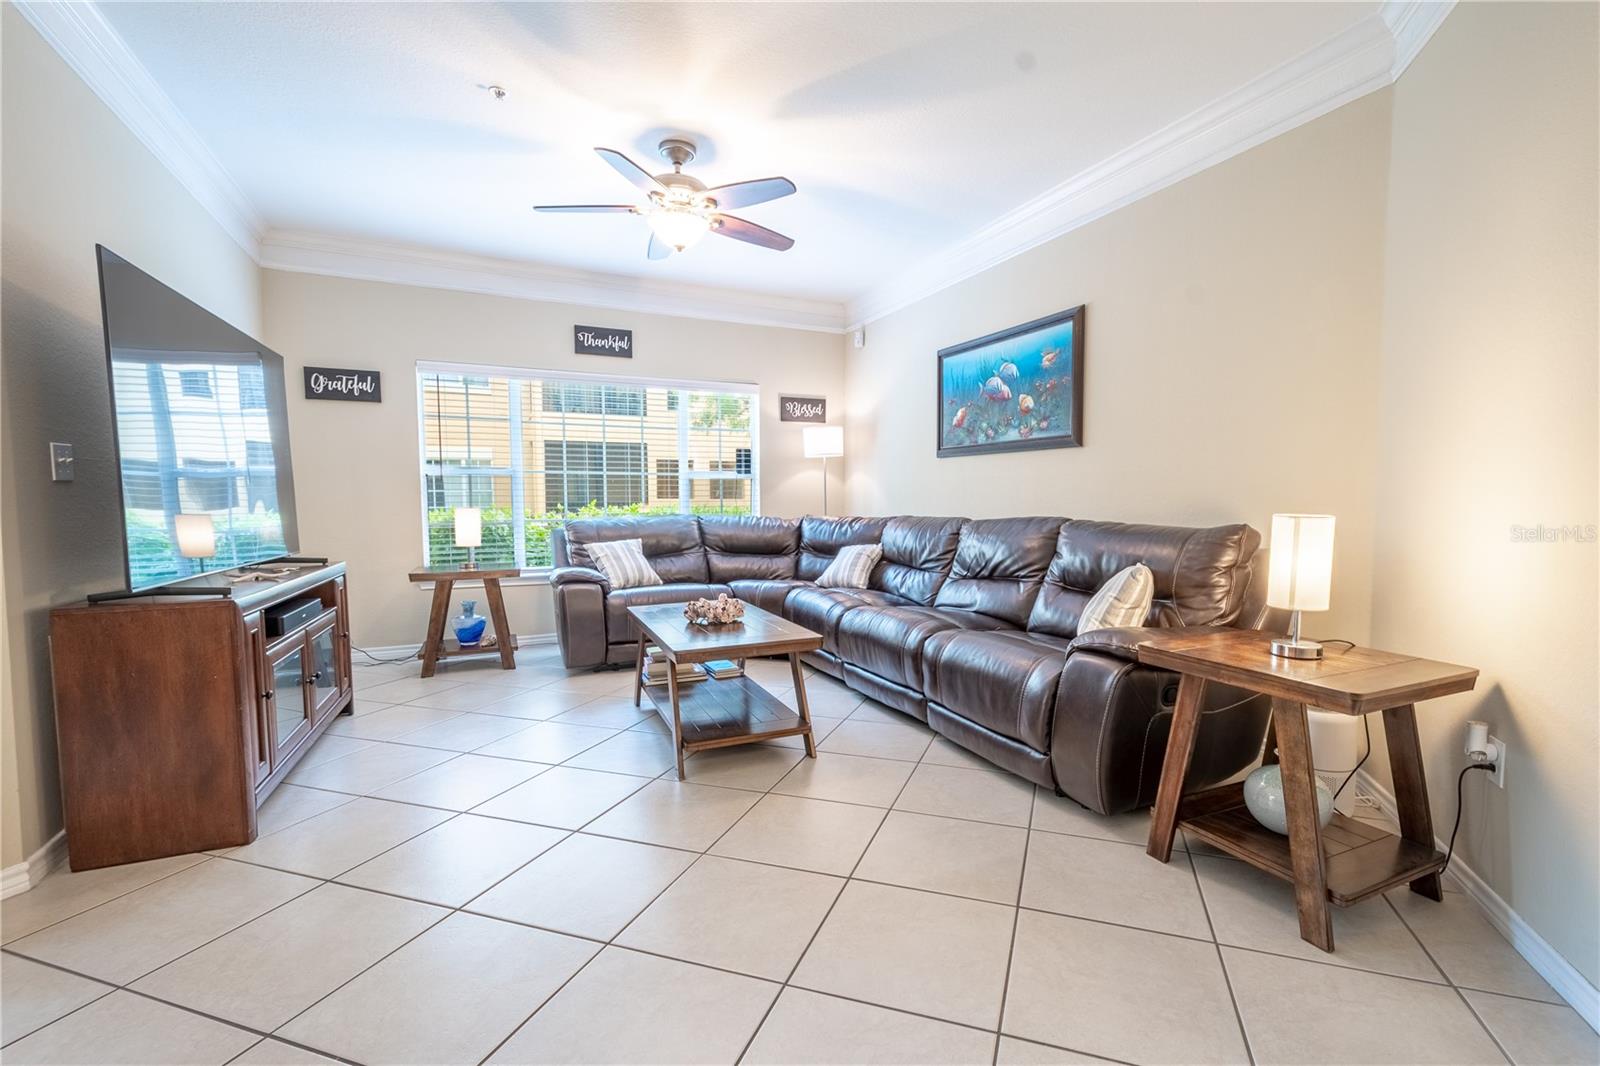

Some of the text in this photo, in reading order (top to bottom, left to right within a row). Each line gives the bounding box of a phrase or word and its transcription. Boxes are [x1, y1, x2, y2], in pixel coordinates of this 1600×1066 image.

[577, 331, 630, 352] Thankful
[310, 373, 376, 396] Grateful
[785, 401, 824, 418] Blessed
